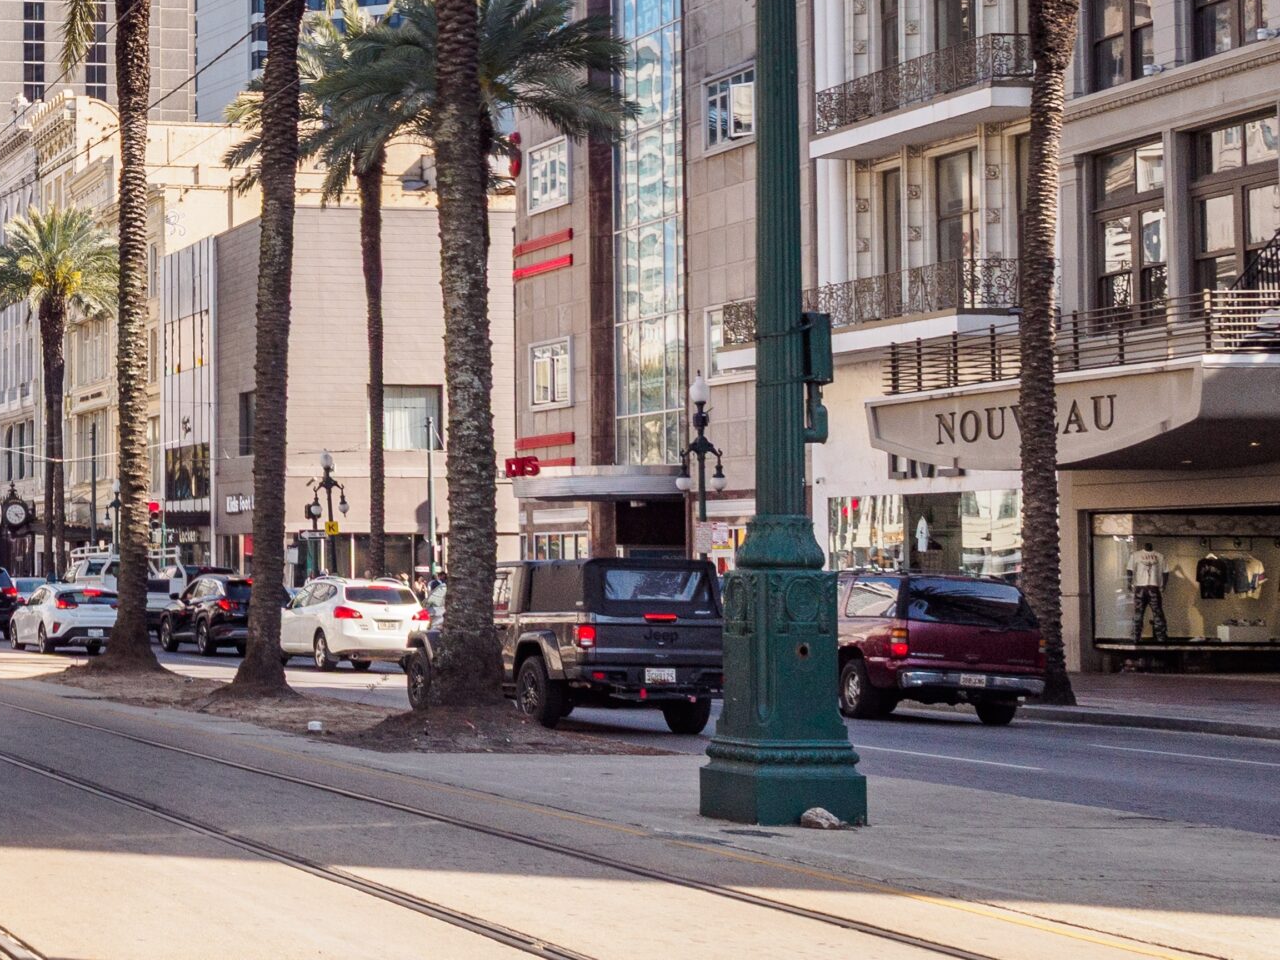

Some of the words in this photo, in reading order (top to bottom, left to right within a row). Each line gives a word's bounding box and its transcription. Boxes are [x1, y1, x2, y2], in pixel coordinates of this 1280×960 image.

[935, 394, 1117, 445] NOUAU
[226, 495, 239, 512] Kids
[328, 524, 335, 532] K
[643, 628, 679, 643] Jeep
